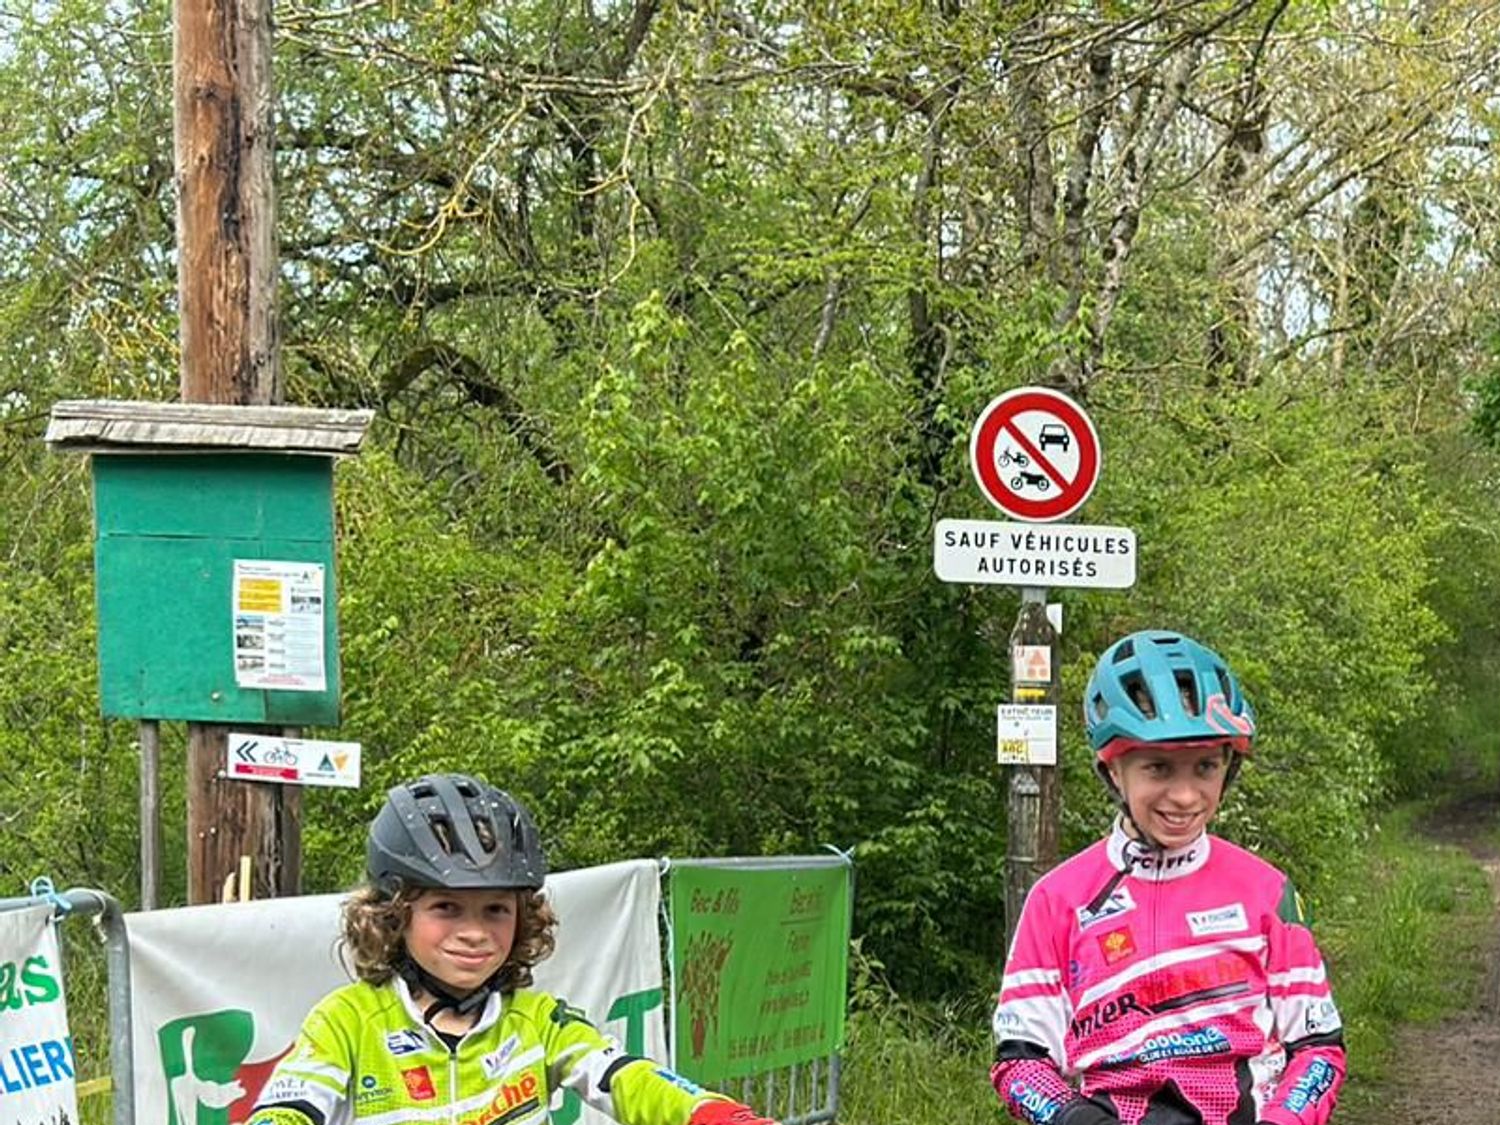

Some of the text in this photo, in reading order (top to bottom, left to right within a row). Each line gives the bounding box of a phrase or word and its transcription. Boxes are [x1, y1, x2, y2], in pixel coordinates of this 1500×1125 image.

[944, 530, 1130, 555] SAUF VÉHICULES
[977, 556, 1098, 578] AUTORISÉS
[0, 1037, 73, 1093] LIER
